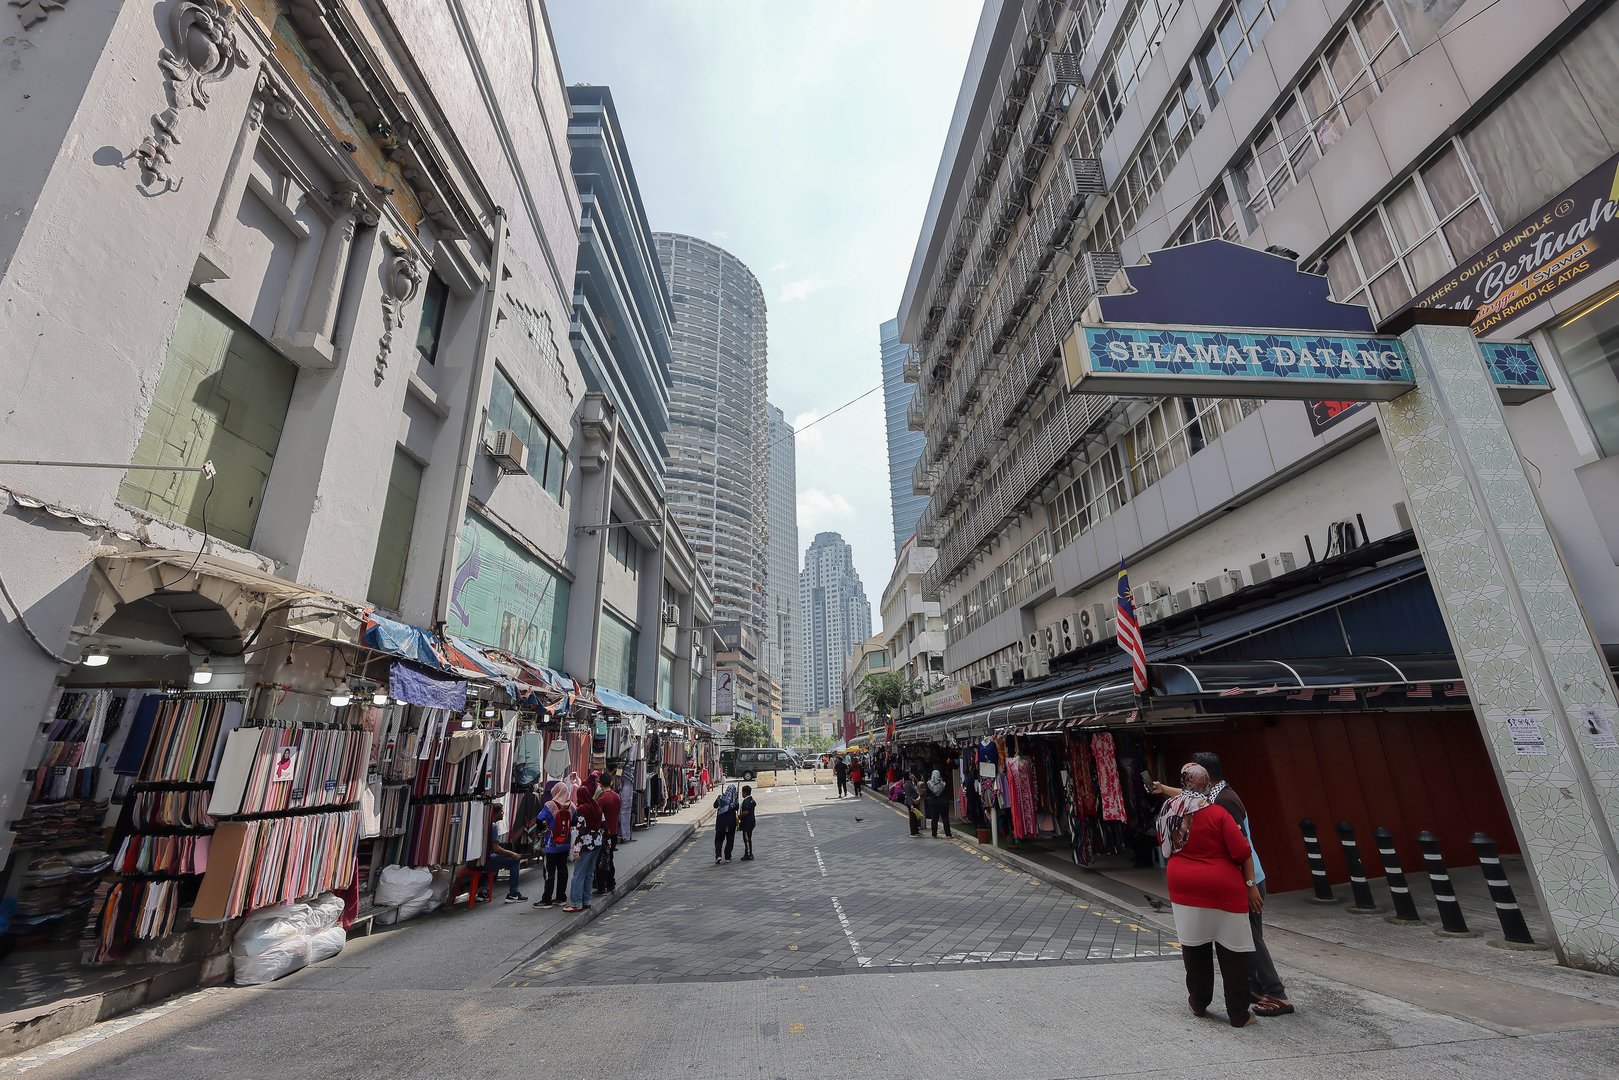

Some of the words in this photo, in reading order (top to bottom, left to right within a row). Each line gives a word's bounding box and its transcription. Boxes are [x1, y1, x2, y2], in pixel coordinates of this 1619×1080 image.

[1415, 278, 1458, 308] OTHERS
[1459, 248, 1500, 281] OUTLET
[1502, 213, 1553, 253] BUNDLE
[1475, 198, 1618, 304] Bertuah
[1521, 278, 1531, 290] 7
[1532, 244, 1589, 285] Syawal
[1502, 292, 1537, 316] RM100
[1538, 280, 1556, 297] KE
[1557, 261, 1590, 286] ATAS
[1108, 340, 1264, 366] SELAMAT
[1275, 347, 1404, 370] DATANG
